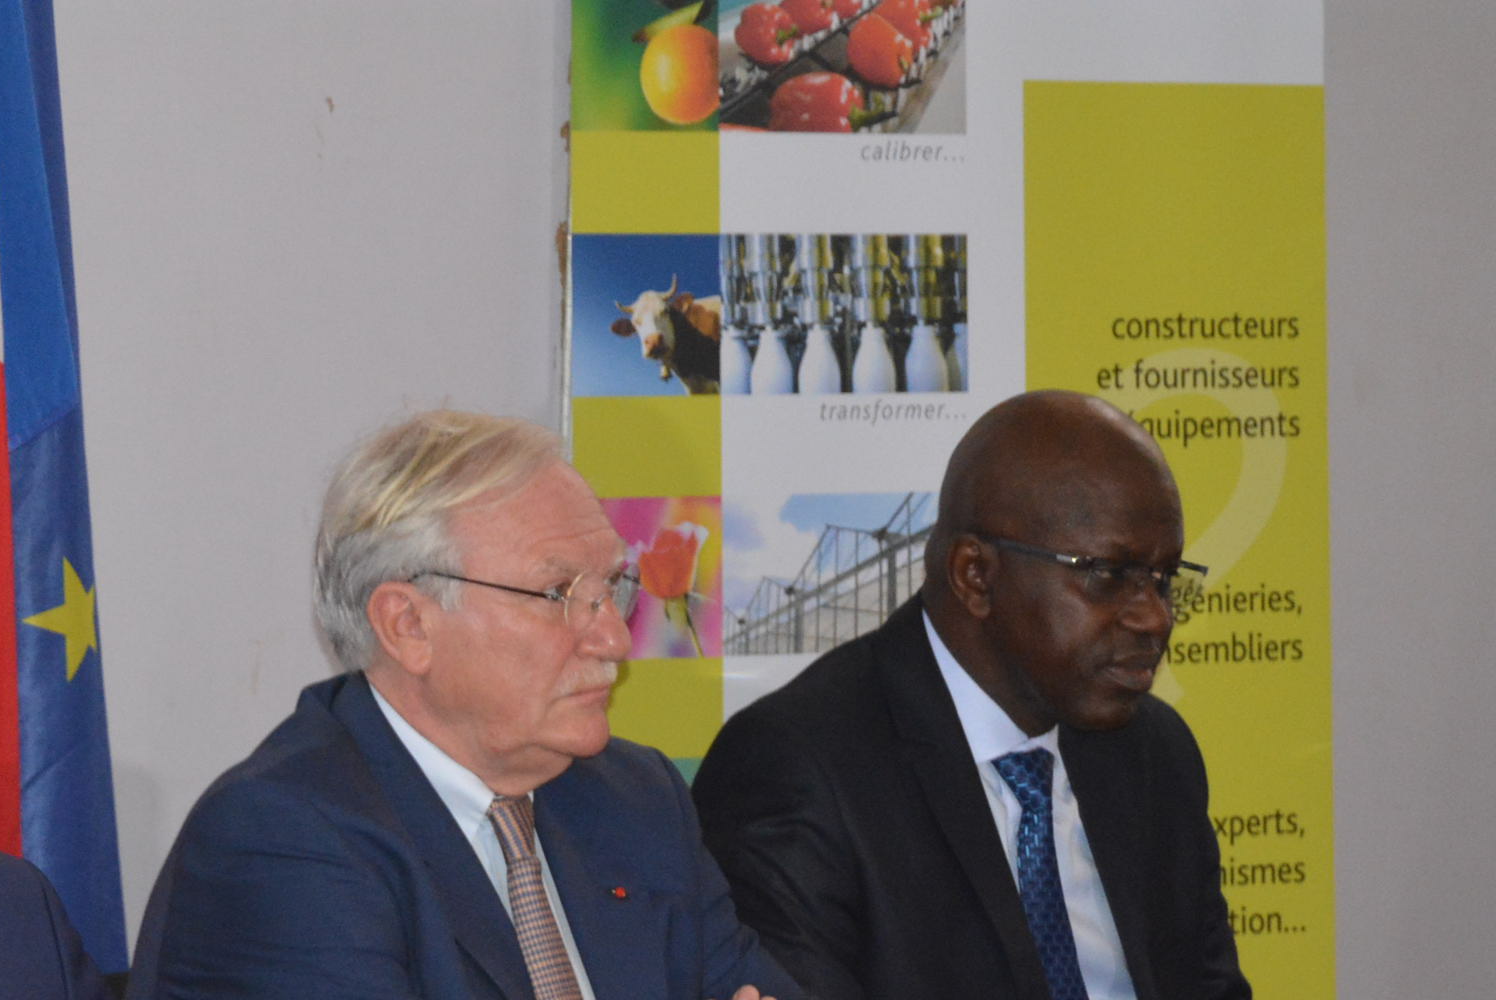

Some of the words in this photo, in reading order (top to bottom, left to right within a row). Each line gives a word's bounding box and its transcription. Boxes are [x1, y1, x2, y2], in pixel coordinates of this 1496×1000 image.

[861, 139, 965, 161] calibrer...
[1111, 312, 1300, 340] constructeurs
[1097, 363, 1123, 390] et
[1134, 358, 1300, 390] fournisseurs
[819, 398, 967, 426] transformer...
[1213, 809, 1305, 846] xperts,
[1220, 857, 1306, 887] ismes
